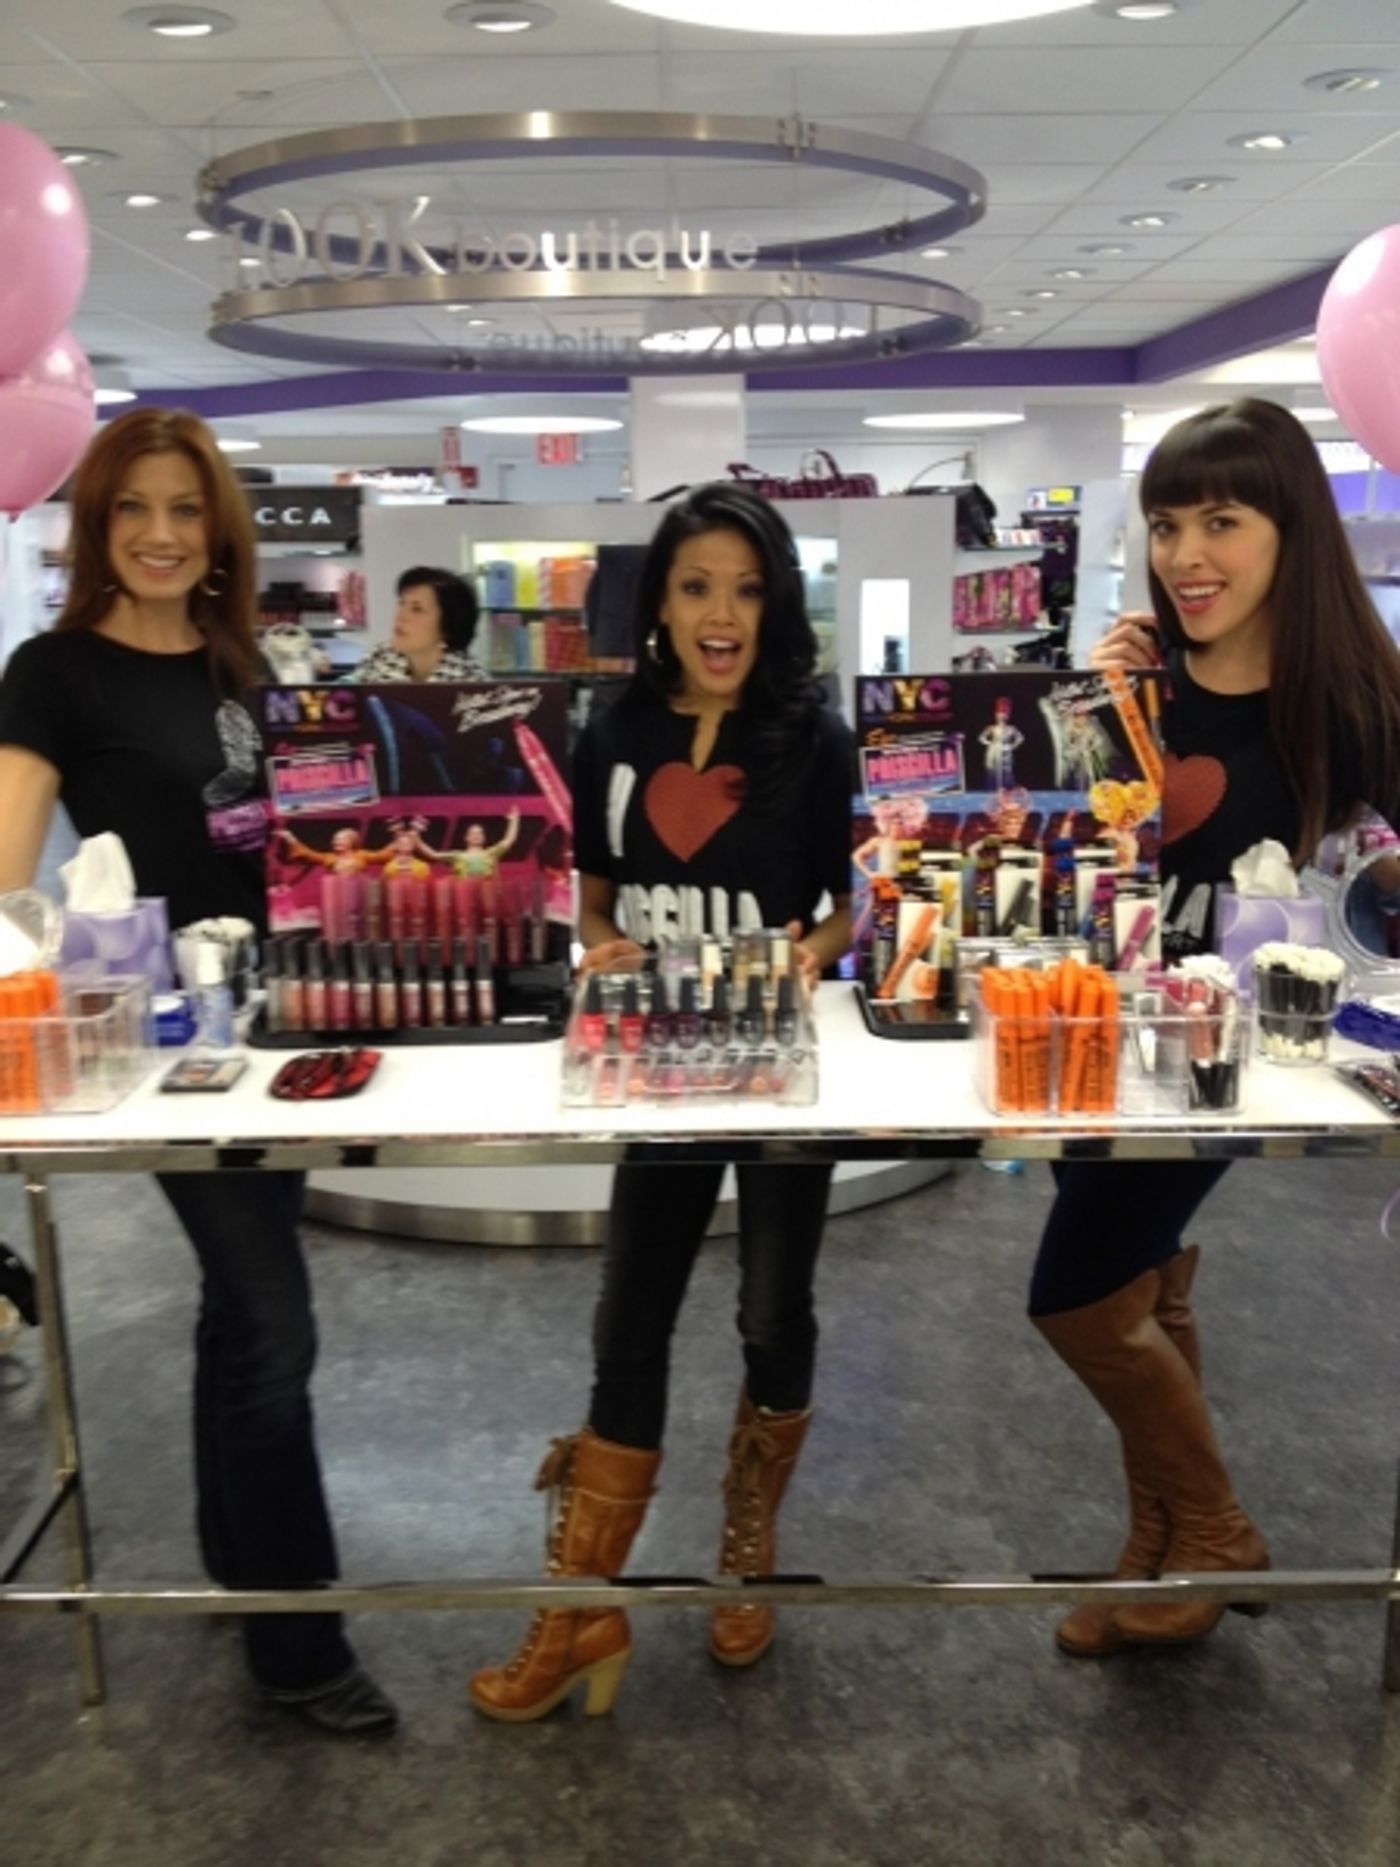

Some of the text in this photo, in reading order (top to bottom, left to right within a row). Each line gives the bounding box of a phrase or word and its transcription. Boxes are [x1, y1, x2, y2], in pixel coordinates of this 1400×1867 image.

[453, 217, 758, 283] boutique
[255, 506, 332, 525] CCA
[266, 690, 356, 723] NYC
[863, 679, 950, 713] NYC
